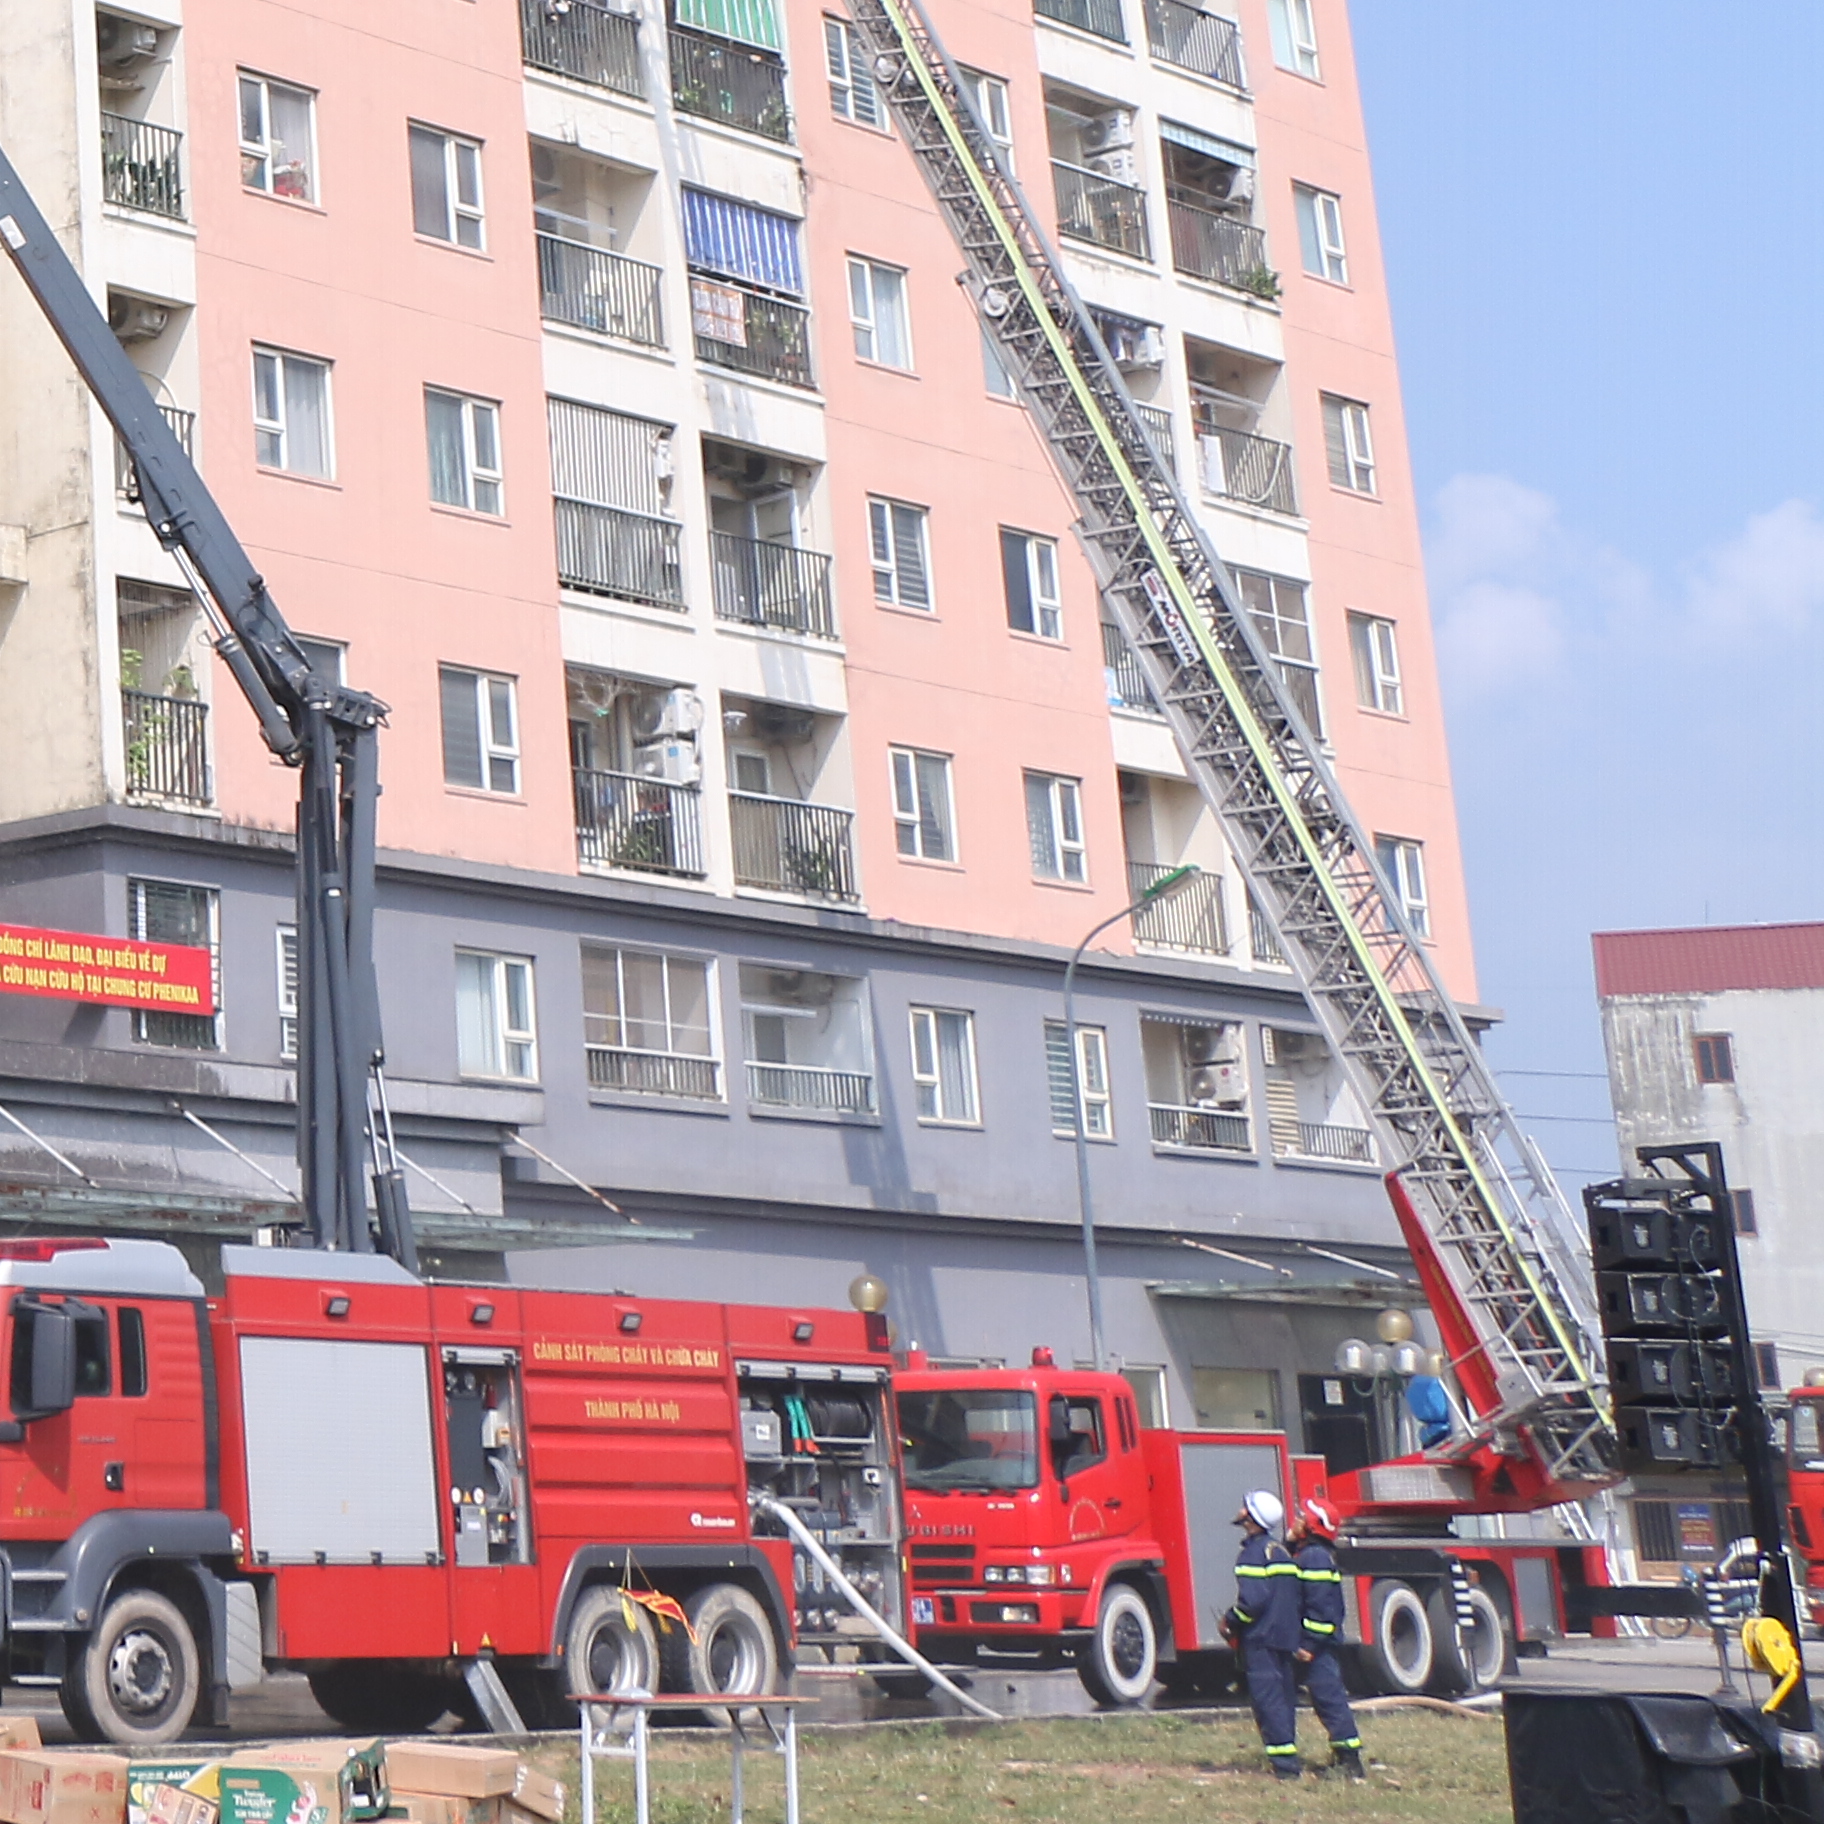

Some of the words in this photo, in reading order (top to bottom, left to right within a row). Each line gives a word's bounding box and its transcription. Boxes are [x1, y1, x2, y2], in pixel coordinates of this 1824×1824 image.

[26, 937, 43, 959] CHÍ
[44, 940, 70, 962] LÃNH
[73, 945, 95, 968] ĐẠO,
[96, 947, 113, 970] ĐẠI
[115, 945, 137, 971] BIỂU
[138, 949, 151, 972] VỀ
[152, 955, 167, 976] DỰ
[3, 963, 23, 985] CỨU
[25, 968, 47, 990] NẠN
[49, 968, 69, 990] CỨU
[71, 971, 85, 995] HỘ
[86, 975, 102, 997] TẠI
[104, 976, 136, 998] CHUNG
[138, 979, 152, 998] CƯ
[153, 982, 200, 1005] PHENIKAA
[533, 1336, 563, 1361] CẢNH
[564, 1341, 584, 1362] SÁT
[585, 1341, 621, 1364] PHÒNG
[622, 1344, 648, 1365] CHÁY
[650, 1344, 665, 1365] VÀ
[665, 1345, 693, 1367] CHỮA
[693, 1347, 719, 1368] CHÁY
[584, 1397, 620, 1419] THÀNH
[621, 1396, 643, 1420] PHỐ
[645, 1398, 660, 1420] HÀ
[661, 1400, 681, 1424] NỘI
